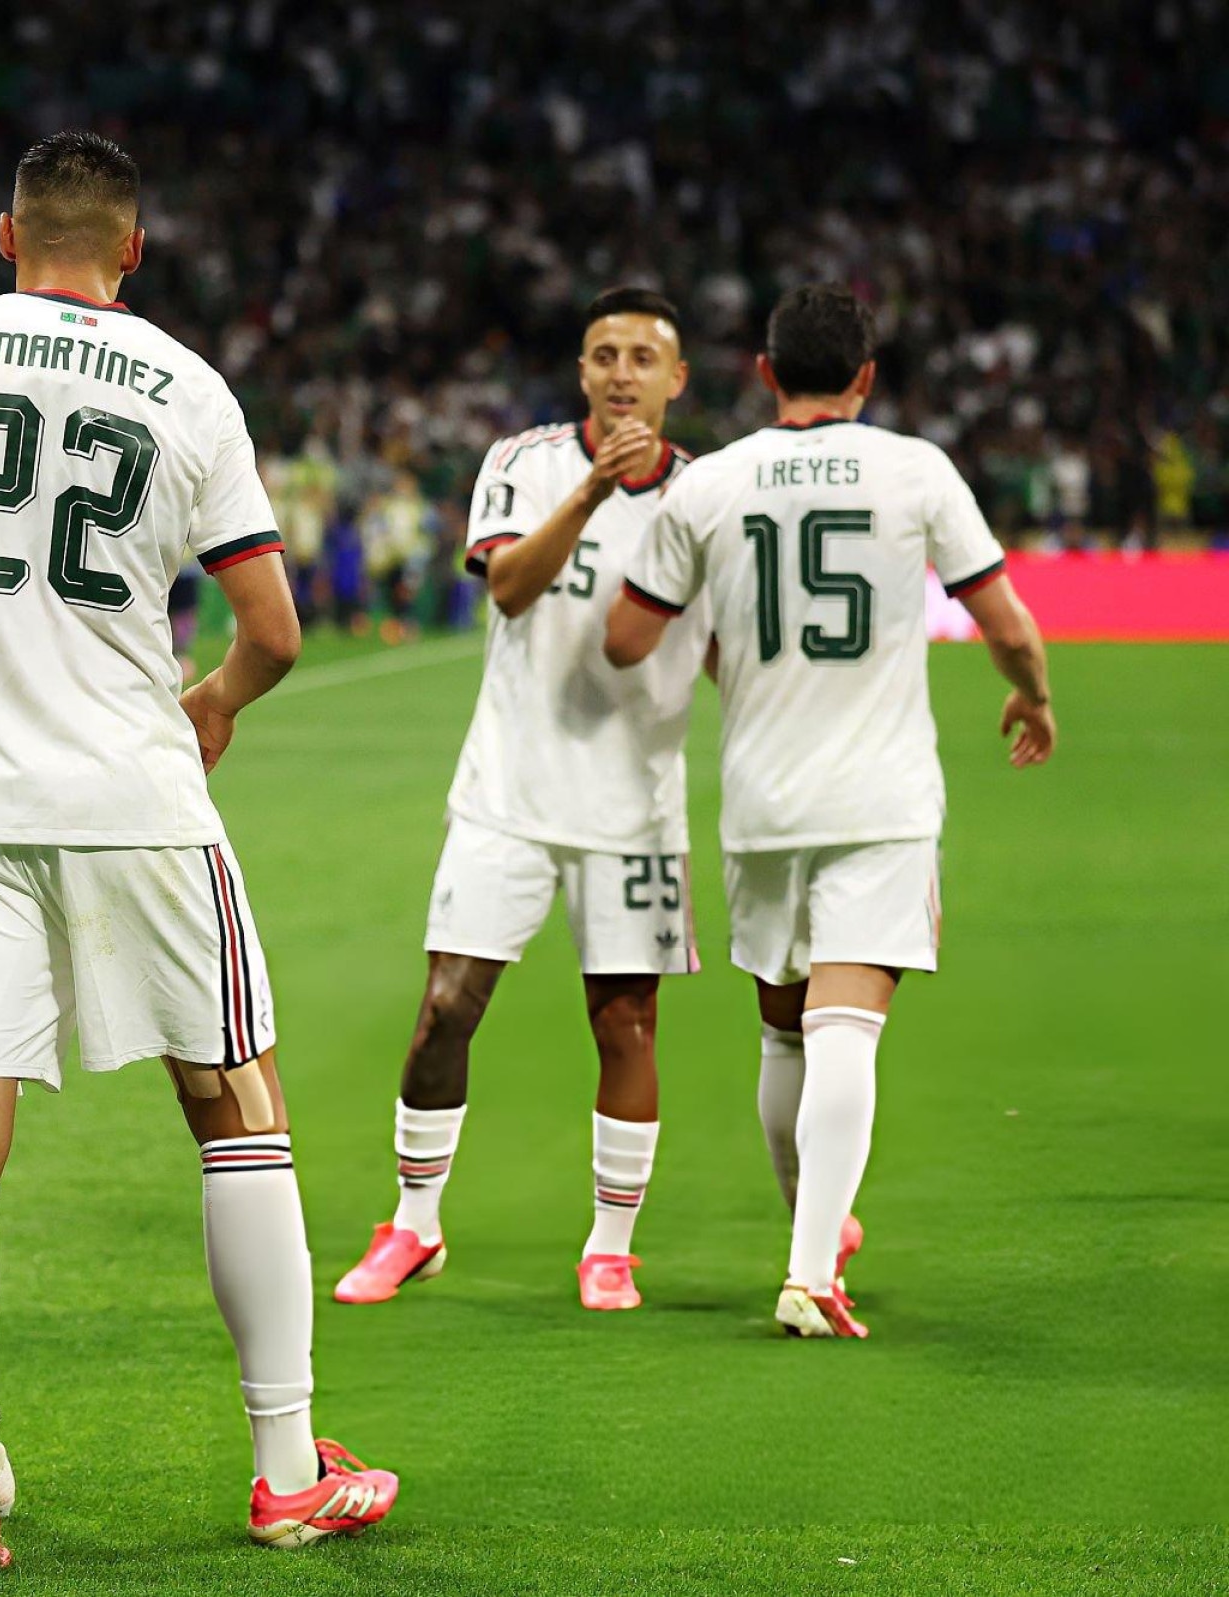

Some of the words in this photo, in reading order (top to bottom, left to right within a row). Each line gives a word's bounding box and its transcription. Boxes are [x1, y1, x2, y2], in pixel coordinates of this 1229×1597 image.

[757, 458, 860, 488] I.REYES
[549, 540, 599, 599] 5
[741, 509, 874, 664] 15
[622, 854, 680, 910] 25
